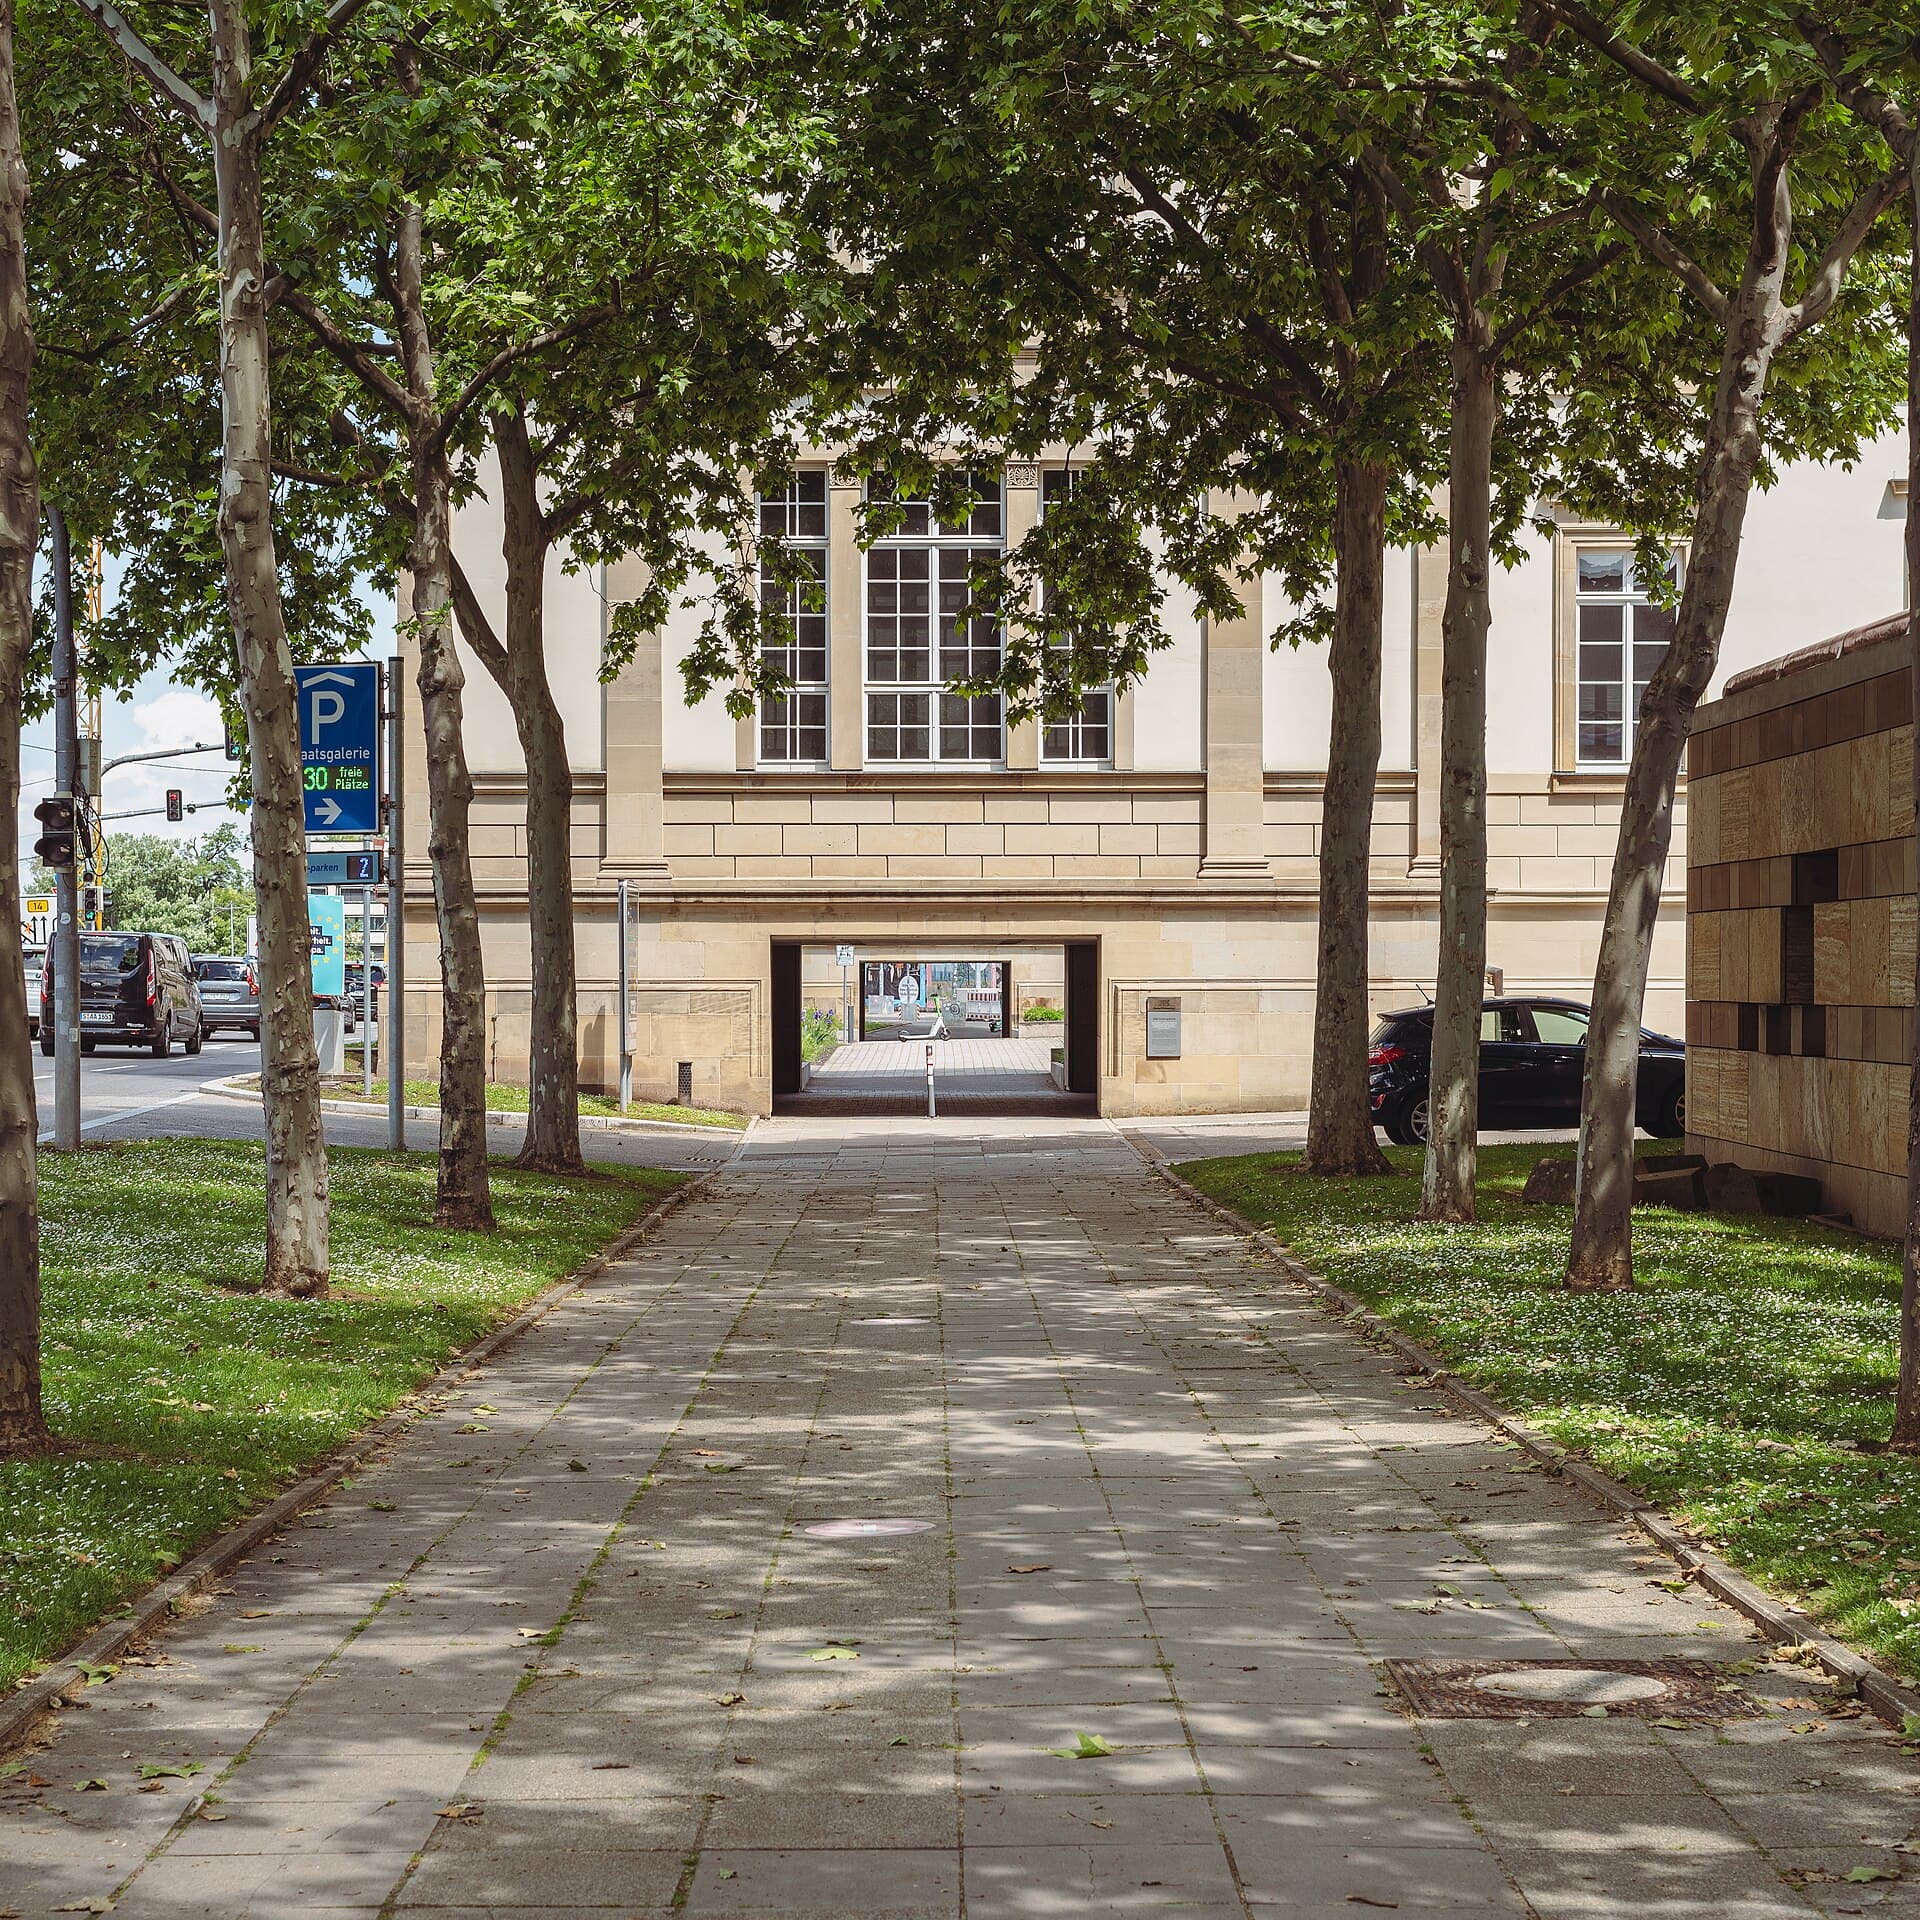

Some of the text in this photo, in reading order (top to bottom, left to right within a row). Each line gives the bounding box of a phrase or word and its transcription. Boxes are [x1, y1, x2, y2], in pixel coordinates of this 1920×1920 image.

[312, 691, 345, 744] P
[301, 746, 370, 763] aatsgalerie
[303, 766, 328, 790] 30
[339, 766, 363, 778] freie
[335, 778, 369, 790] Plätze
[307, 863, 339, 874] -parken
